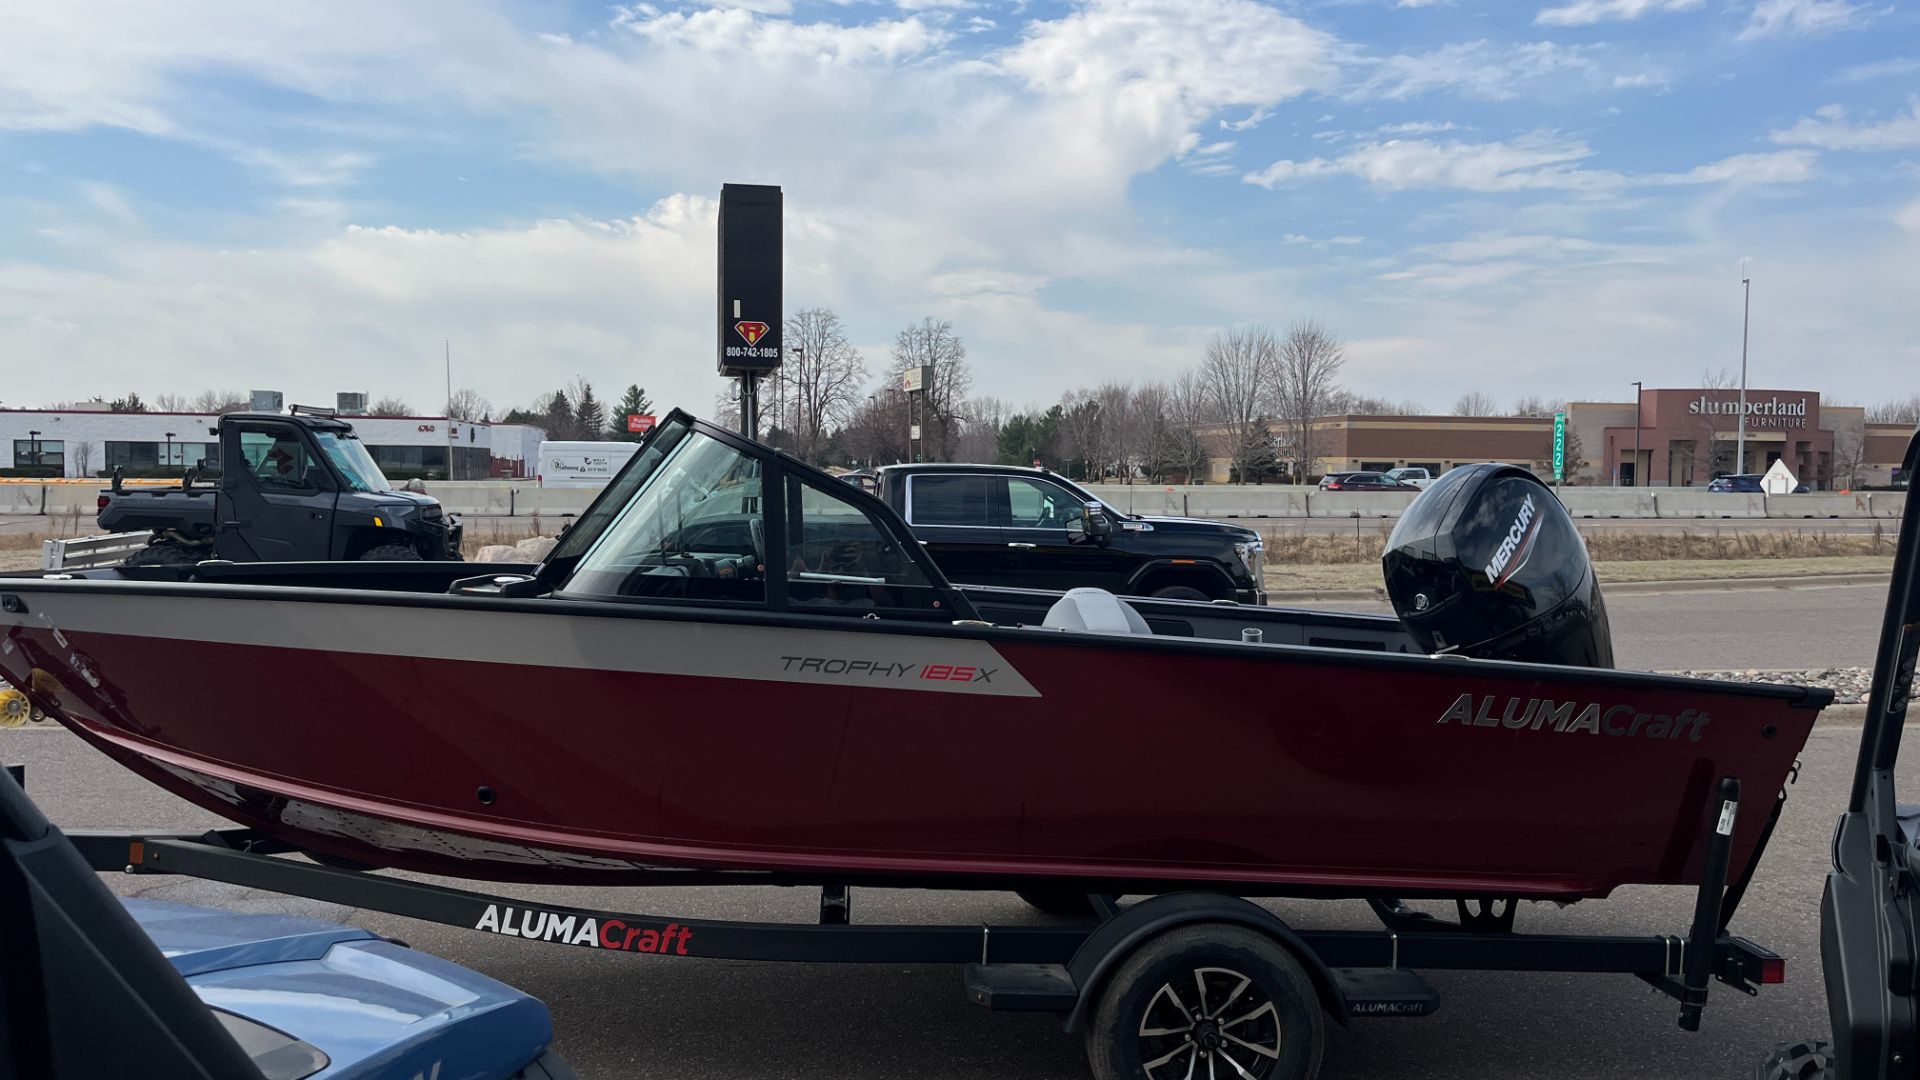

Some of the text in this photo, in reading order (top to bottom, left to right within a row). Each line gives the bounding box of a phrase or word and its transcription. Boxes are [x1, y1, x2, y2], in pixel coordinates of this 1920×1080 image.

[726, 346, 778, 358] 800-742-1805
[1688, 395, 1806, 416] slumberland
[1744, 417, 1807, 429] FURNITURE
[1555, 424, 1563, 466] 222
[1485, 492, 1535, 584] MERCURY
[781, 656, 917, 678] TROPHY
[1437, 693, 1711, 742] ALUMACraft
[474, 904, 694, 955] ALUMACraft
